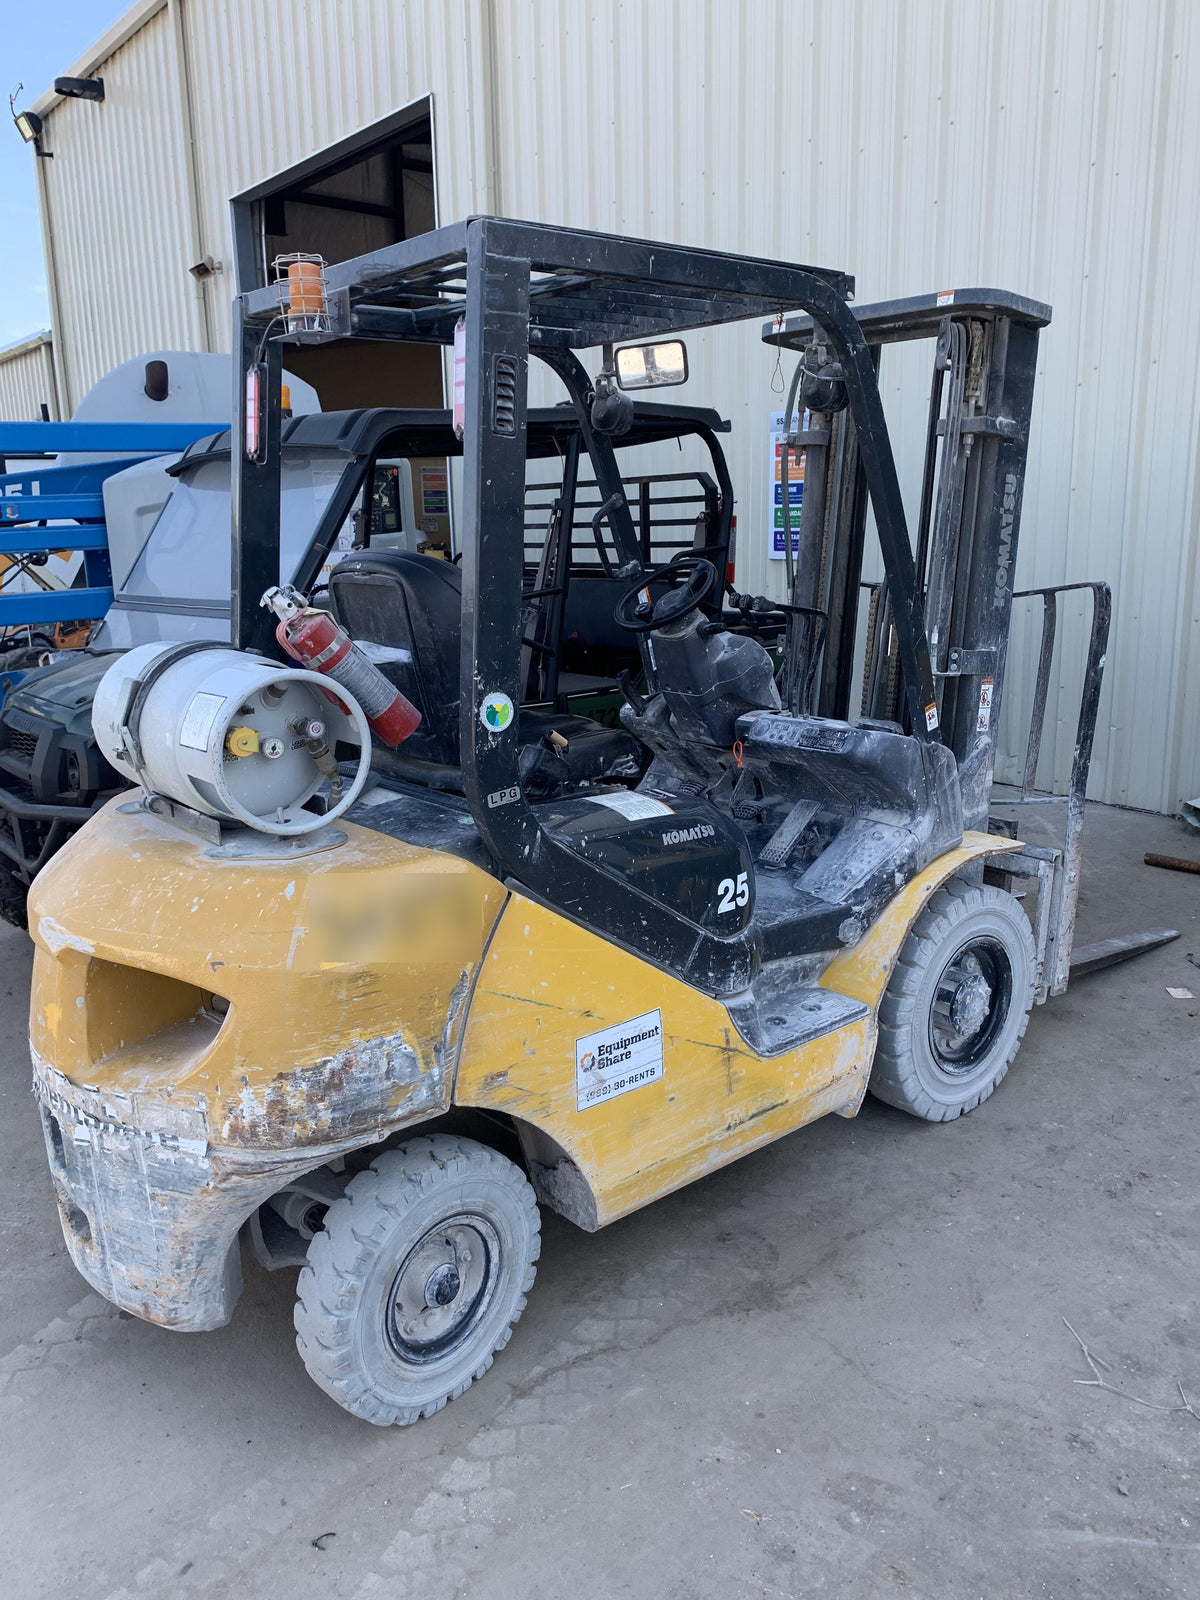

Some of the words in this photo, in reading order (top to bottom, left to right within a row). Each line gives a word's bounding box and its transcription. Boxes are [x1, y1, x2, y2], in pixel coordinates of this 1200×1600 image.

[993, 473, 1017, 607] KOMATSU
[490, 787, 518, 805] LPG
[661, 823, 716, 846] KOMATSU
[717, 871, 749, 914] 25
[597, 1025, 660, 1057] Equipment
[597, 1050, 632, 1070] Share
[613, 1067, 656, 1091] 30-RENTS
